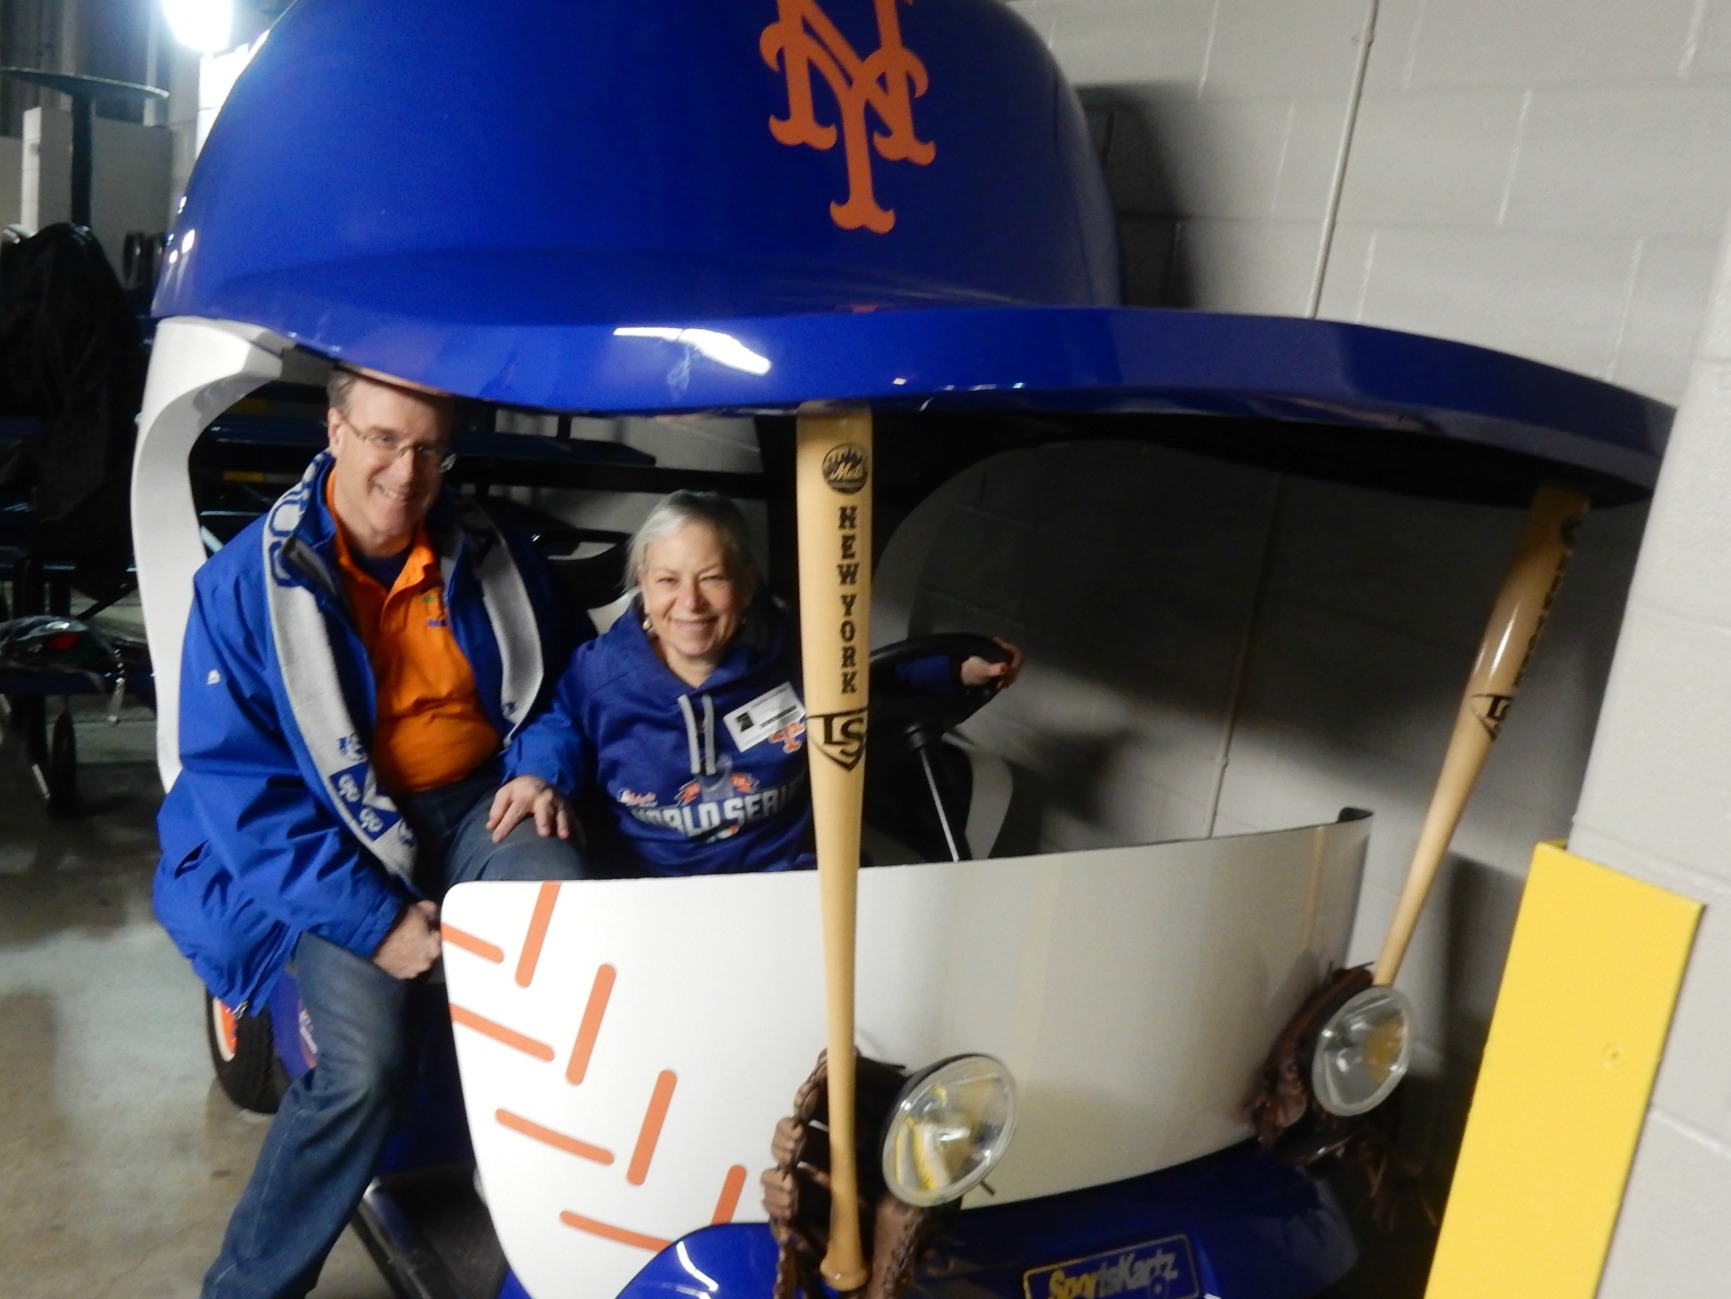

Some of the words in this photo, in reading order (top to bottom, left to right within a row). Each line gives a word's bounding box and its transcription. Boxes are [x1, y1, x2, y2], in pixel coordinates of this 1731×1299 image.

[837, 505, 860, 586] NEW
[839, 594, 858, 694] YORK
[723, 778, 806, 827] SERI
